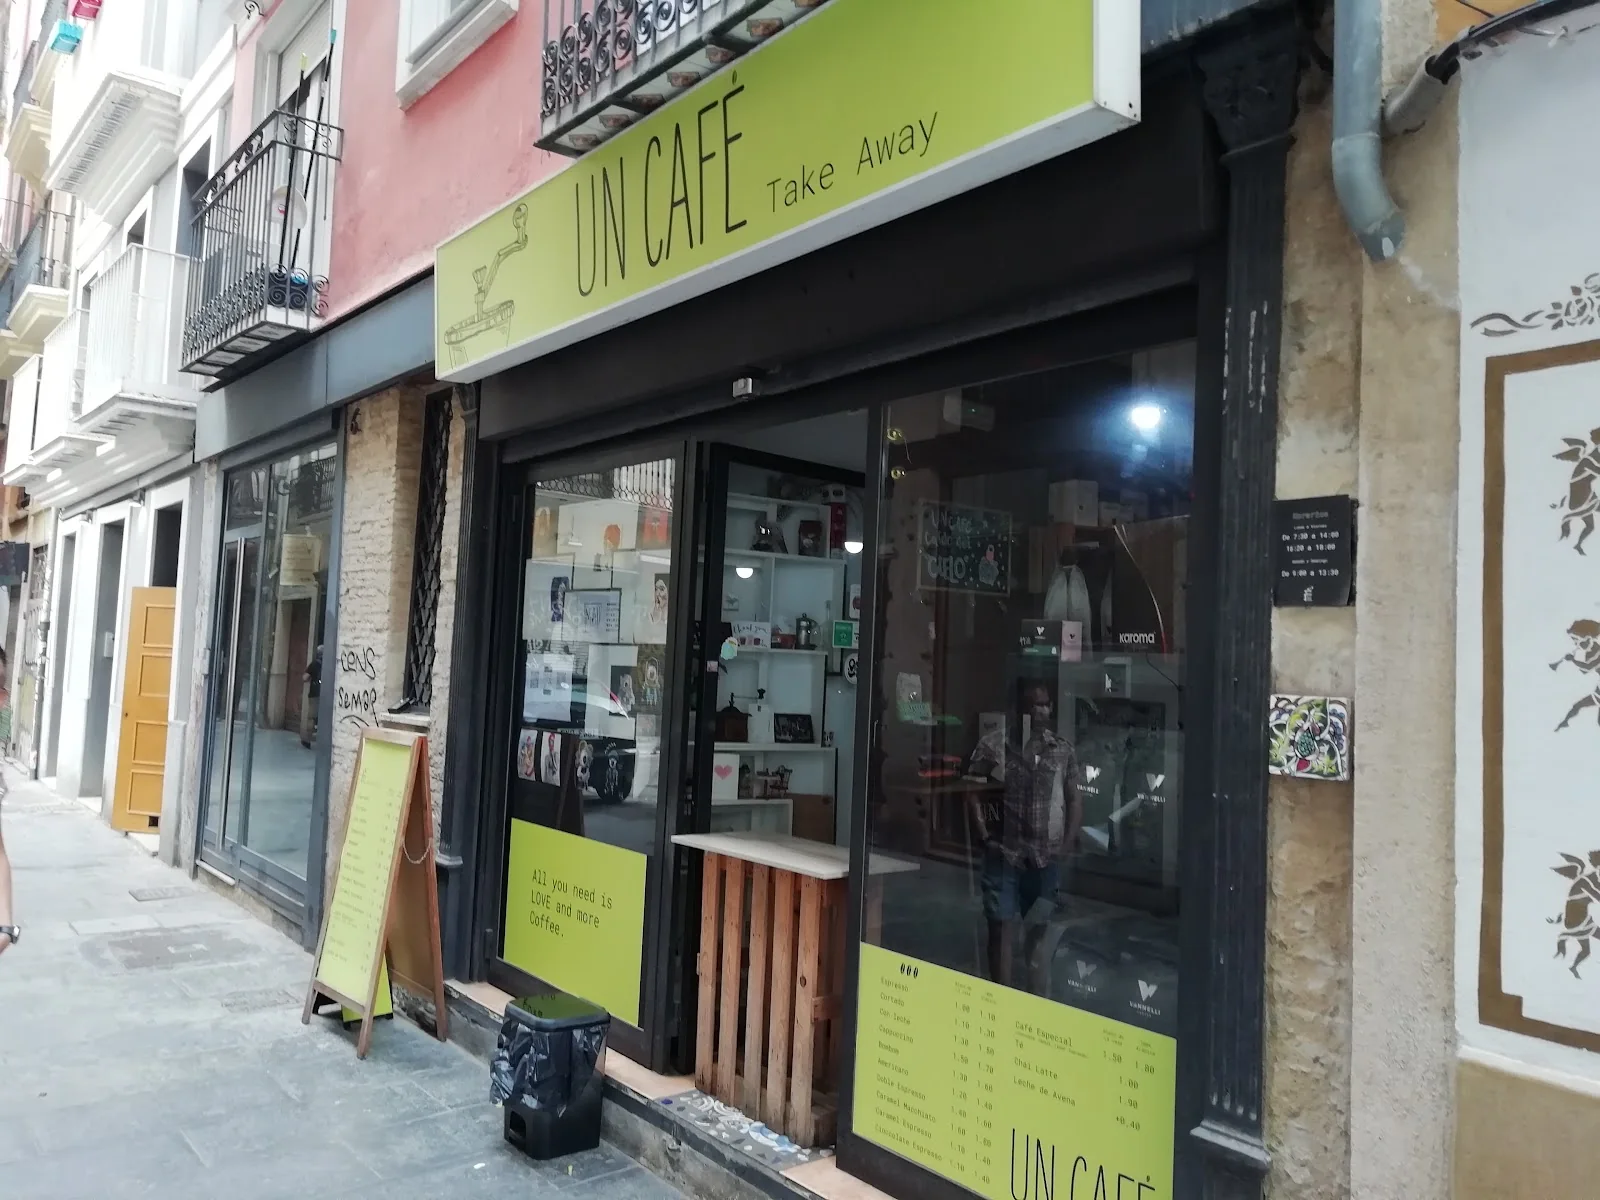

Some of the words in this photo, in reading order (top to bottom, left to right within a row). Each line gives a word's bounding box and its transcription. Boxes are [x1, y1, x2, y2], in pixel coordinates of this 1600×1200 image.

[575, 156, 626, 297] UN
[644, 69, 748, 268] CAFÉ
[767, 163, 834, 213] Take
[857, 111, 938, 175] Away
[1282, 533, 1291, 541] De
[1293, 532, 1309, 540] 7:30
[532, 869, 547, 886] All
[552, 877, 568, 894] you
[572, 883, 595, 904] need
[601, 891, 613, 909] is
[529, 911, 564, 937] Coffee.
[531, 890, 551, 910] LOVE
[555, 903, 572, 918] and
[576, 908, 600, 928] more
[1015, 1021, 1033, 1034] Café
[1036, 1028, 1073, 1048] Especial
[1103, 1050, 1122, 1064] 1.50
[1035, 1064, 1058, 1080] Latte
[1119, 1076, 1139, 1090] 1.00
[1013, 1076, 1035, 1090] Leche
[1039, 1085, 1049, 1096] de
[1052, 1091, 1076, 1107] Avena
[1011, 1128, 1055, 1200] UN
